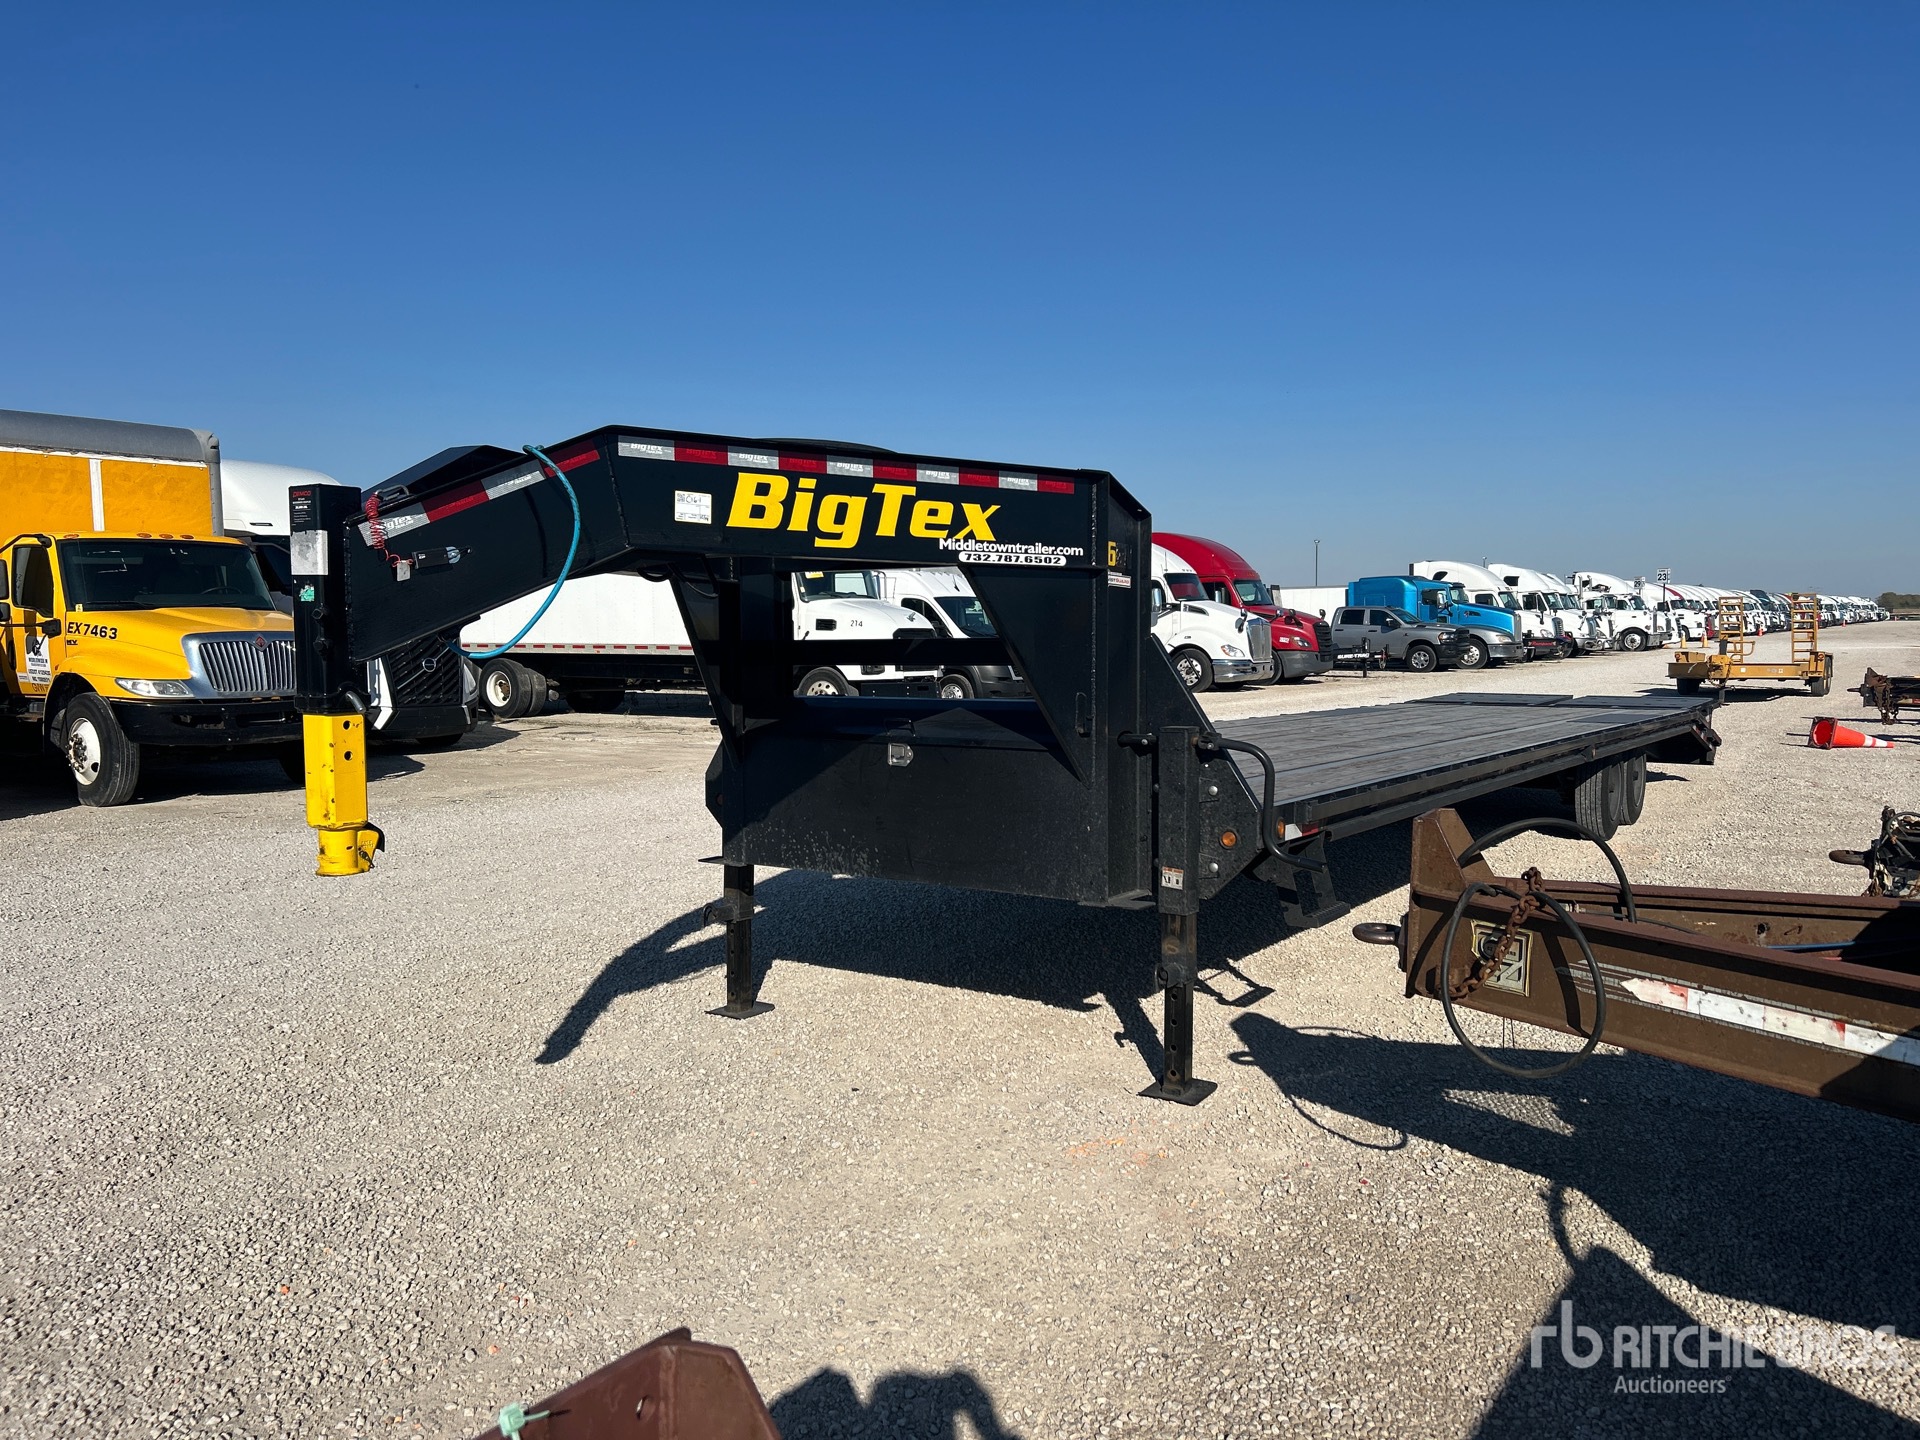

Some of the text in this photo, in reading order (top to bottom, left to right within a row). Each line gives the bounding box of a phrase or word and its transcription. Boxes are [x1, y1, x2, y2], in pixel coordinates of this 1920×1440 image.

[726, 472, 1001, 548] BigTex
[939, 537, 1084, 556] Middletowntrailer.com
[964, 553, 1062, 565] 732.787.6502
[1657, 573, 1667, 581] 23
[67, 621, 118, 640] EX7463
[850, 619, 863, 627] 214
